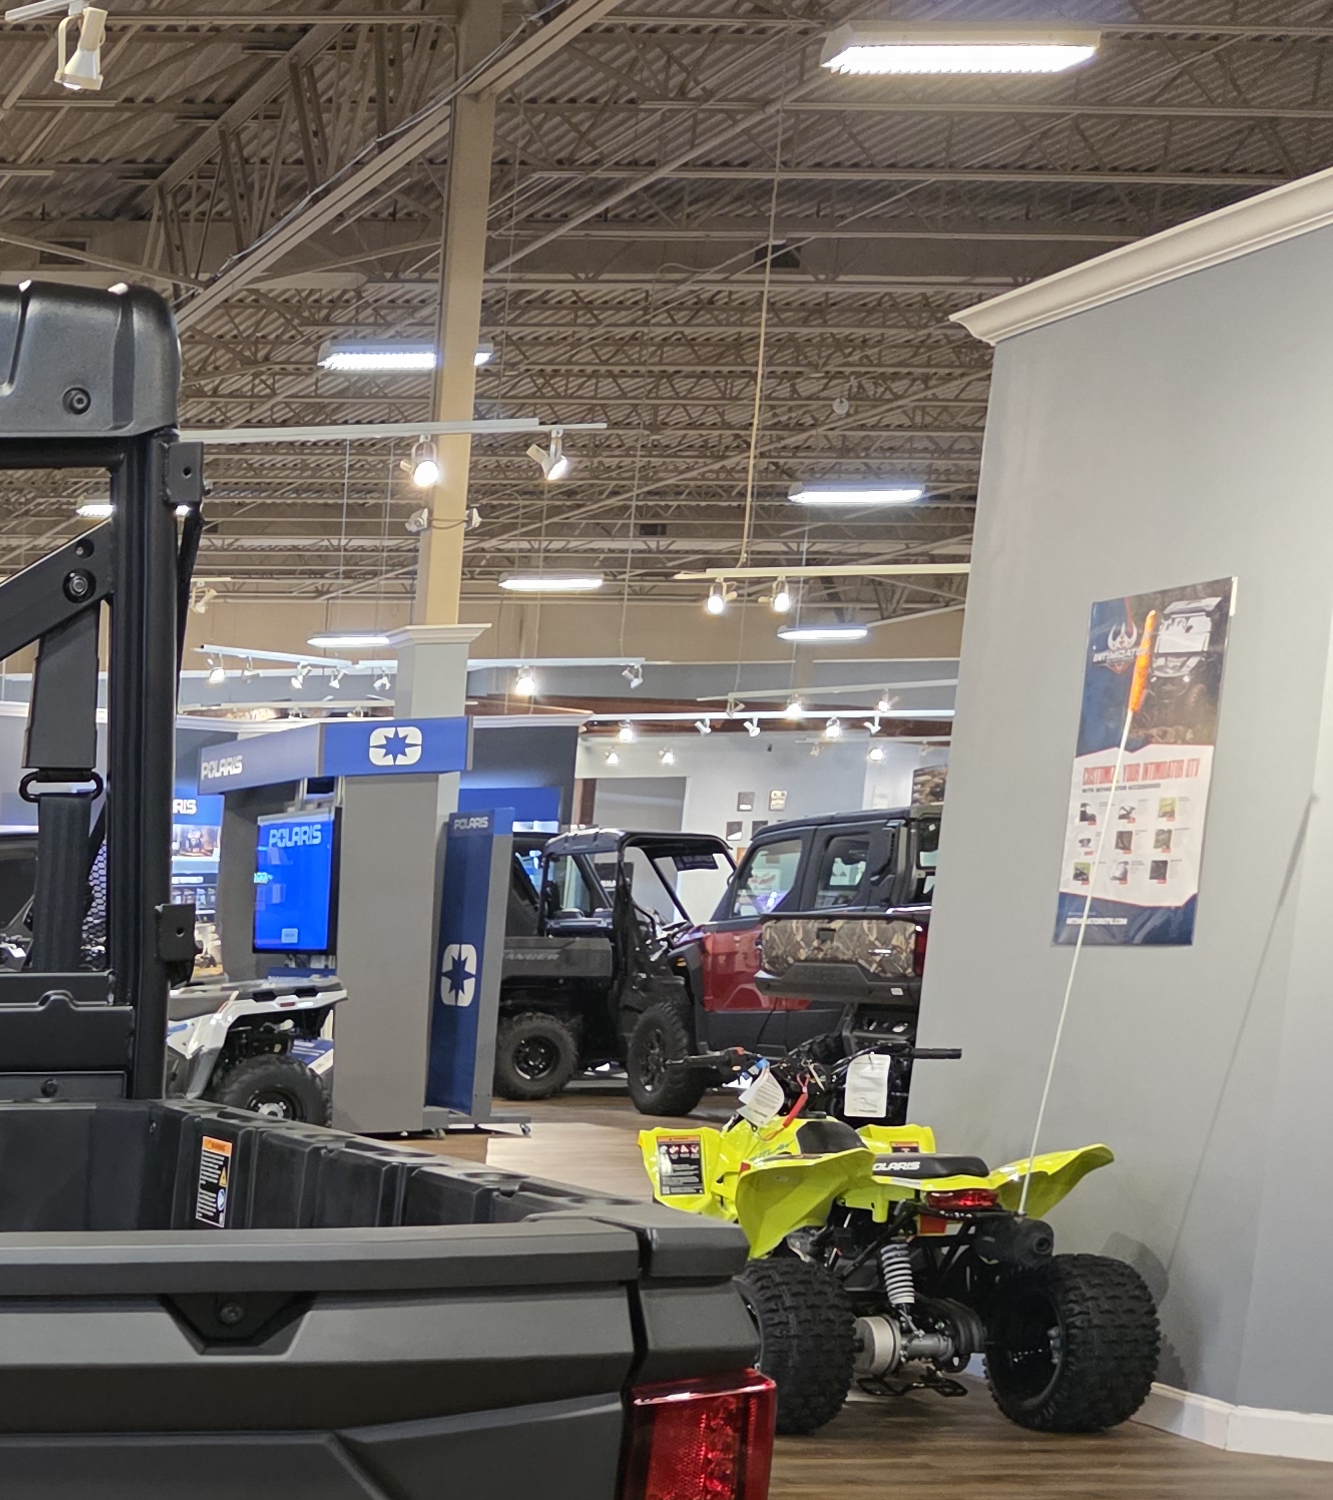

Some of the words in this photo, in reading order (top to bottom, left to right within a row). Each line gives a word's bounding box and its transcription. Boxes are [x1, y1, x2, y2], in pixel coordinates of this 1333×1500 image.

[201, 755, 243, 780] POLARIS
[454, 816, 489, 830] POLARIS
[269, 824, 322, 848] POLARIS
[872, 1161, 921, 1171] OLARIS
